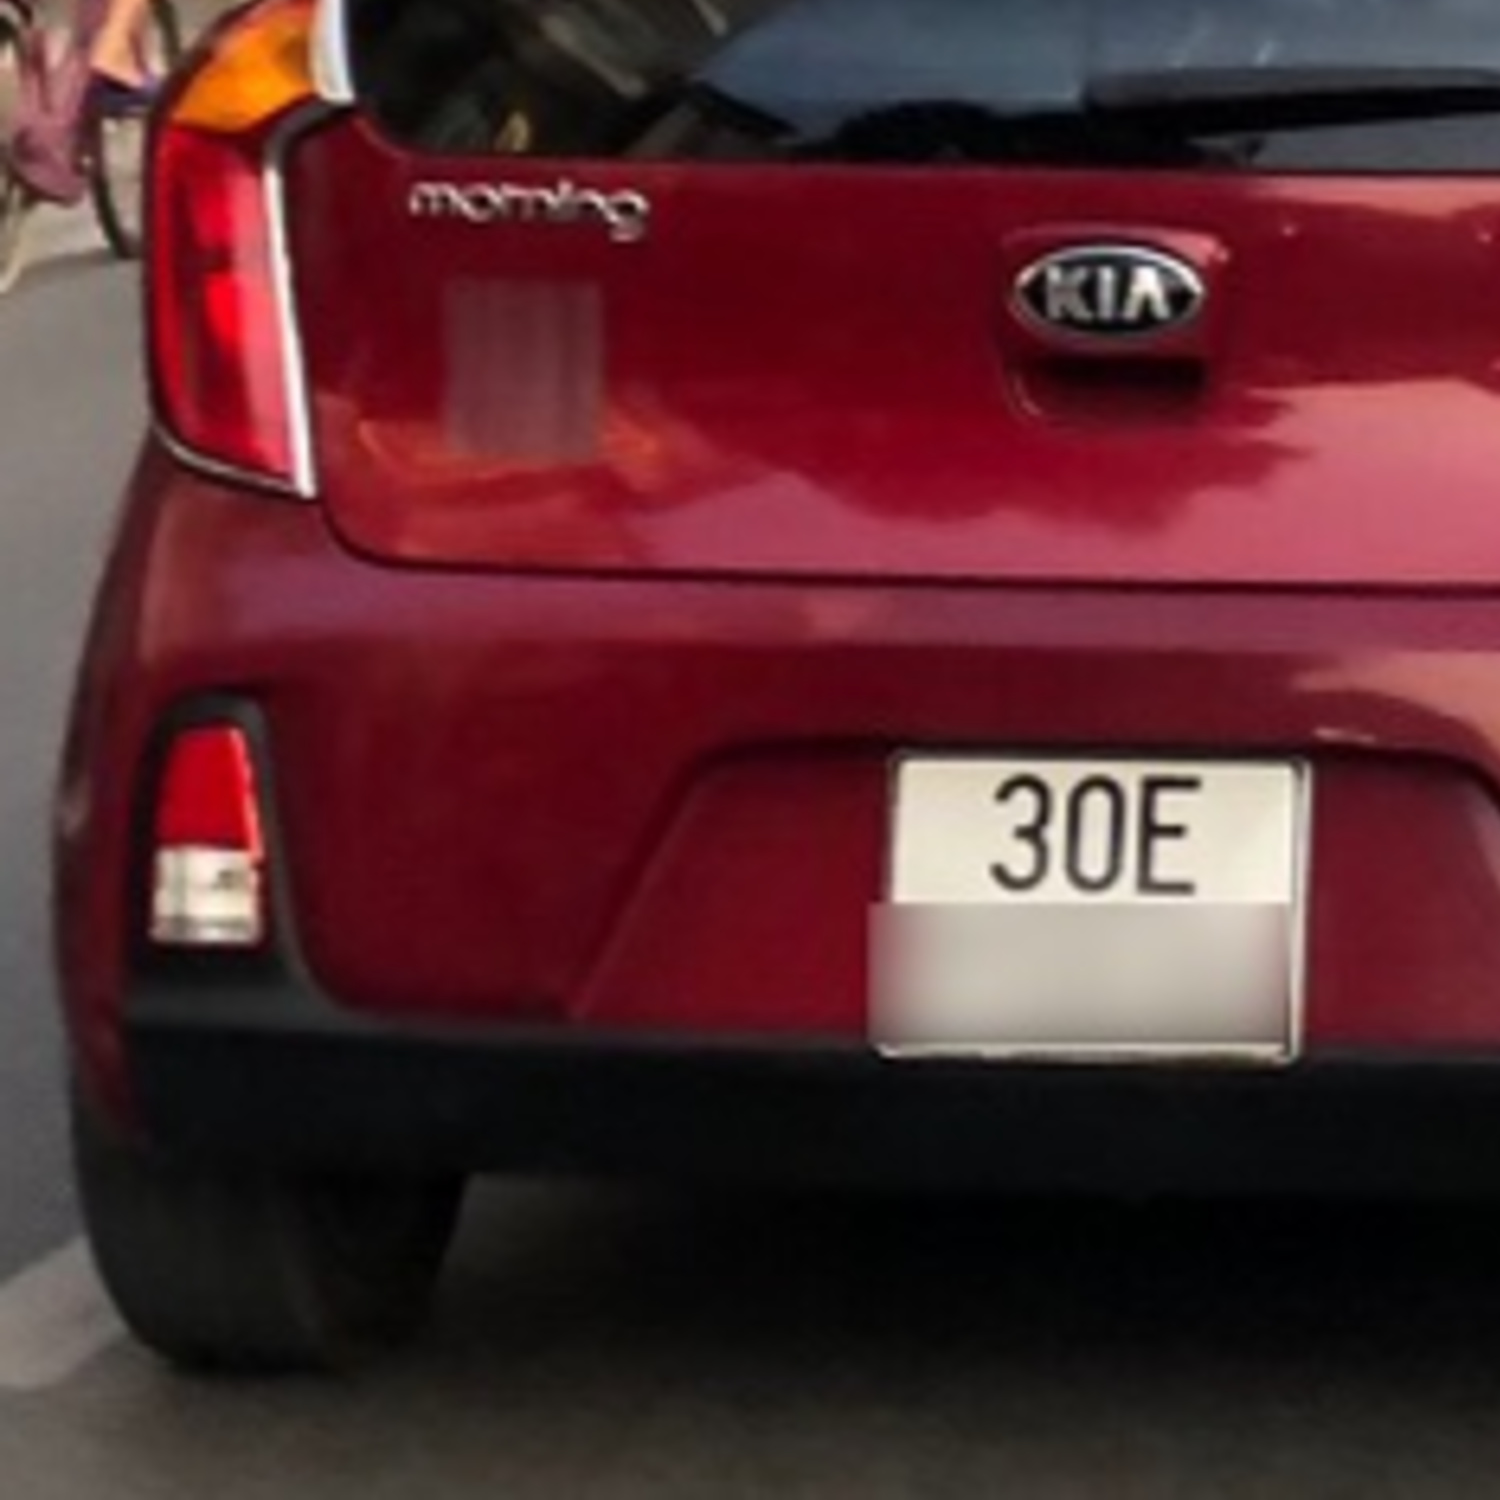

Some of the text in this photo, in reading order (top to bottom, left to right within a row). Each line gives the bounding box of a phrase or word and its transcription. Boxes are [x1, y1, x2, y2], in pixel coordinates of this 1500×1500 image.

[408, 178, 650, 242] morning
[1046, 264, 1172, 322] KIA
[989, 773, 1202, 894] 30E
